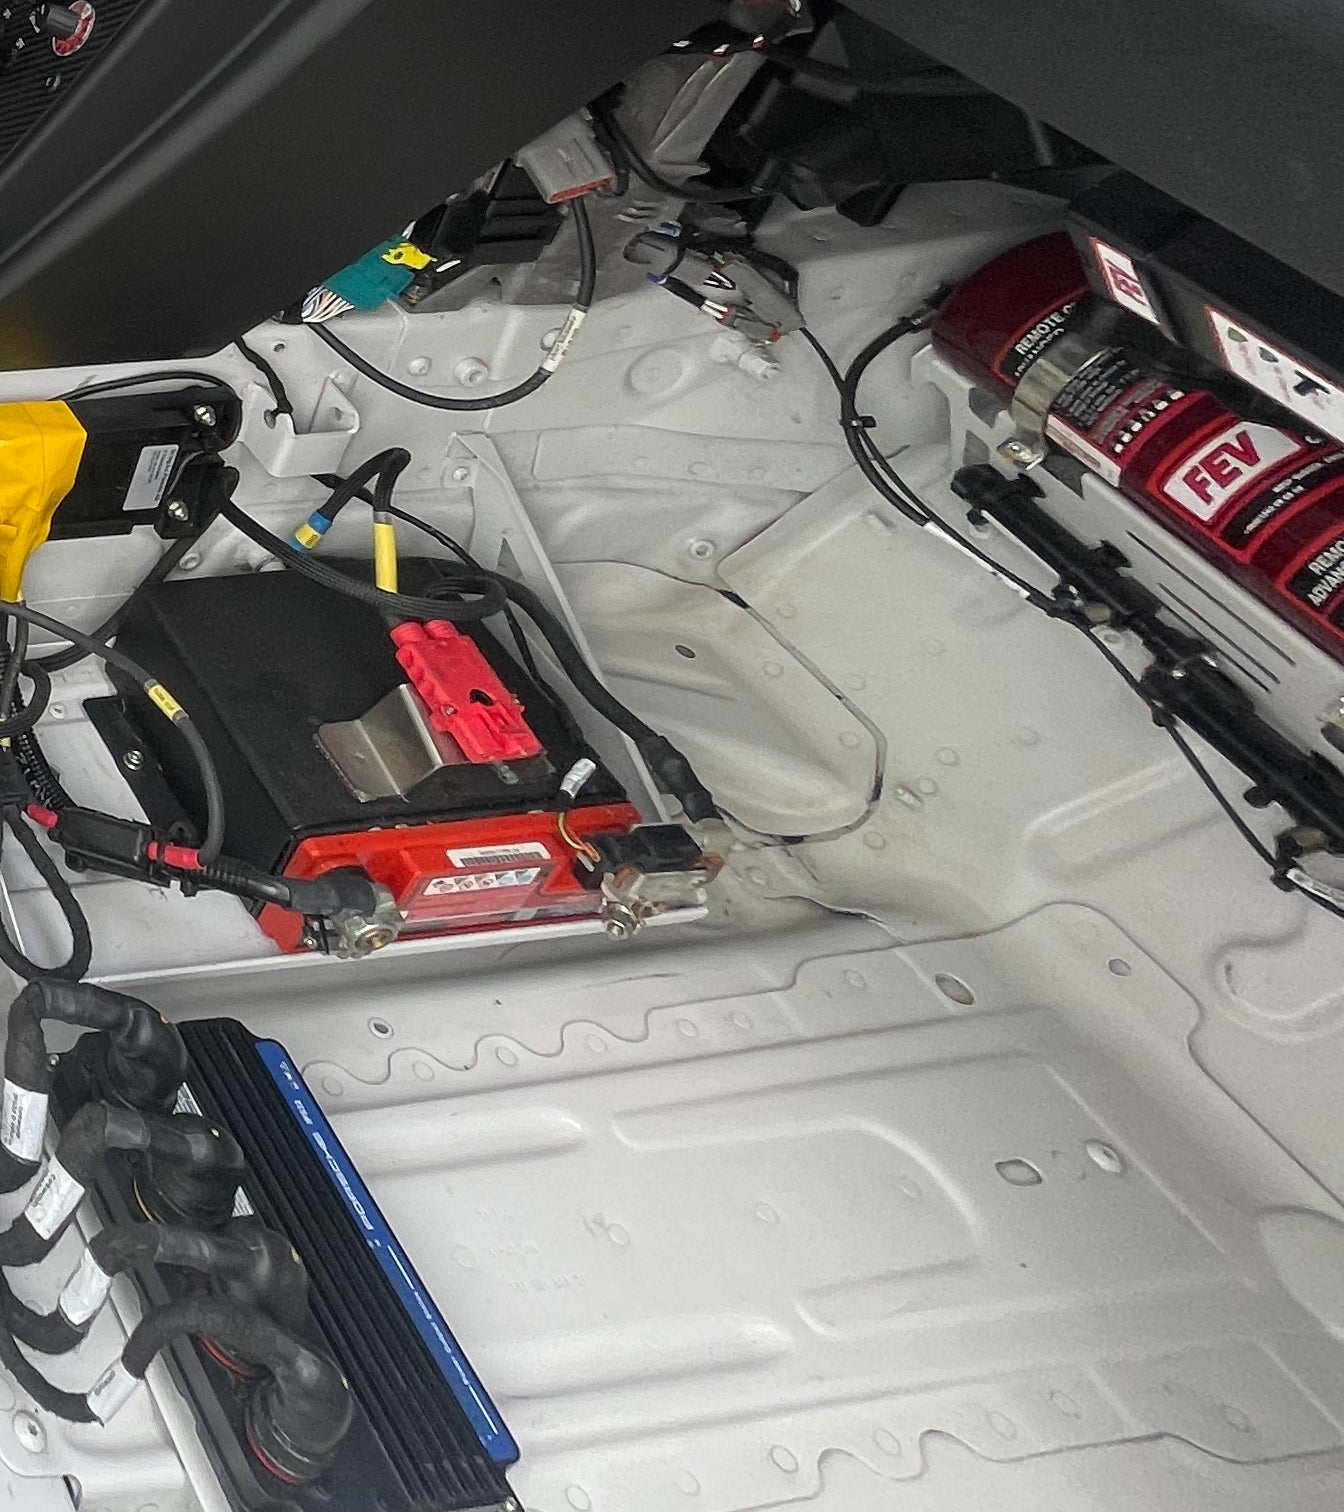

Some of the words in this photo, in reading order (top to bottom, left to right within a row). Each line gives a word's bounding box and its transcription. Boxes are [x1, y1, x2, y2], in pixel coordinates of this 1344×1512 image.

[1014, 310, 1066, 356] REMOTE
[1182, 429, 1261, 507] FEV
[312, 1130, 375, 1232] PORSCHE
